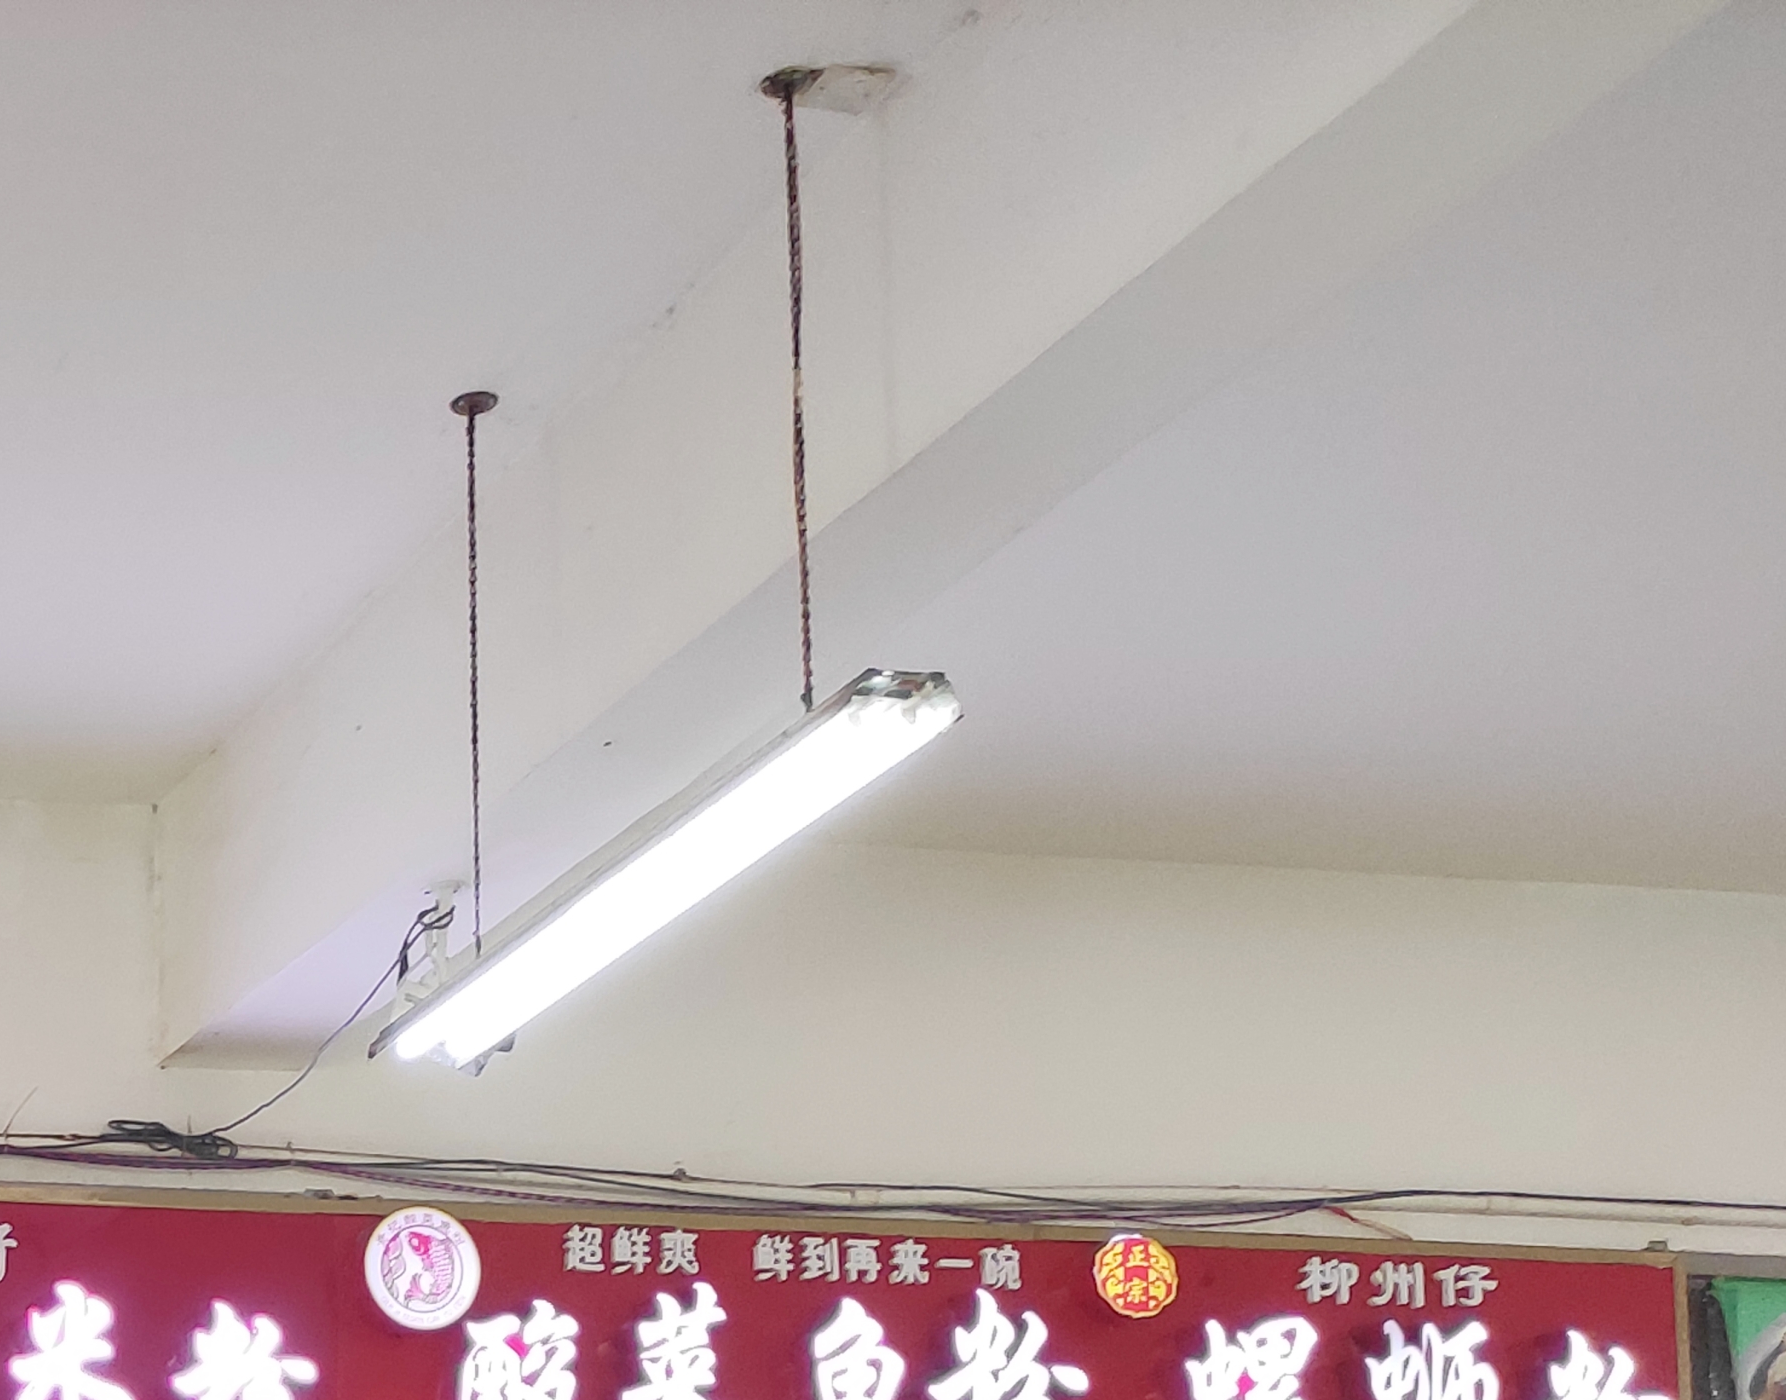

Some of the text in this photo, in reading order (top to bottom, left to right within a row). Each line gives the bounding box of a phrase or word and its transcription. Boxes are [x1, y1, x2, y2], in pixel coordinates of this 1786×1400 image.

[1125, 1244, 1150, 1304] 正宗
[1296, 1255, 1500, 1309] 柳州仔
